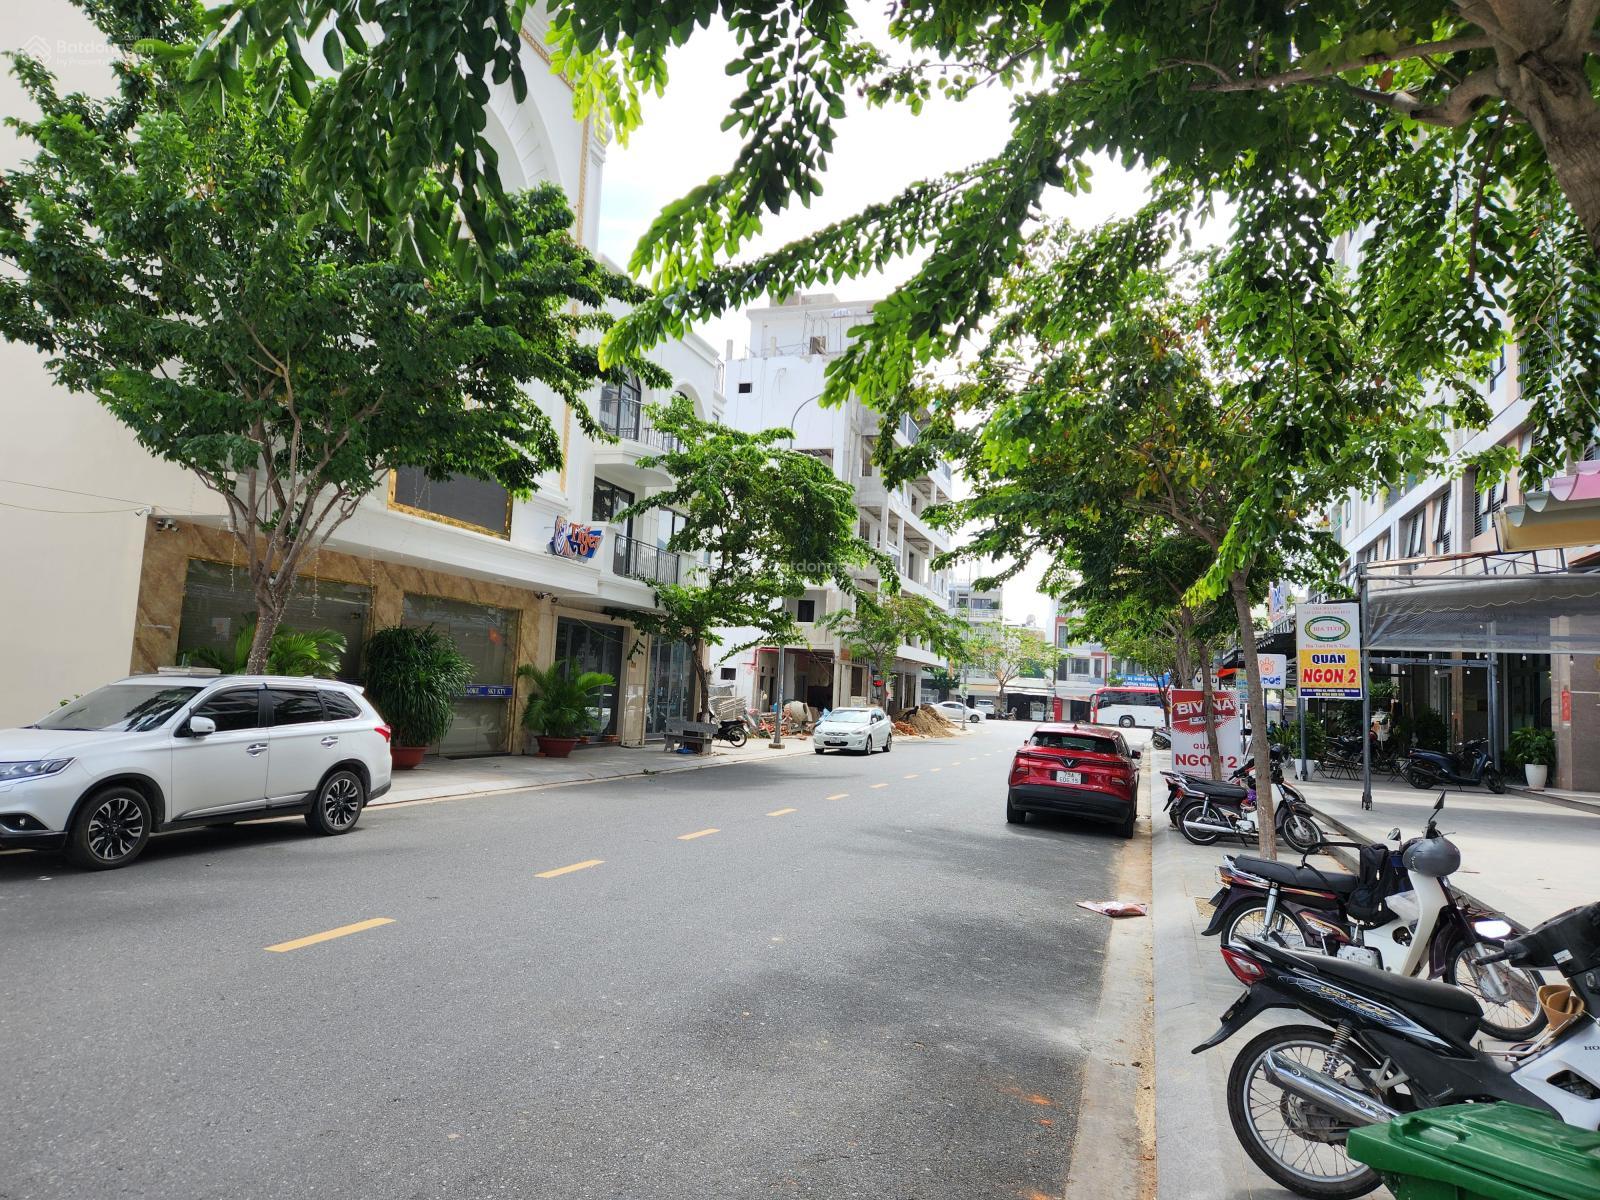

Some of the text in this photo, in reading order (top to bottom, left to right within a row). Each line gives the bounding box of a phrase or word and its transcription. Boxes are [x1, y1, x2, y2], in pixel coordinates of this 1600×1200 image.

[569, 522, 602, 556] Tiger
[1312, 654, 1345, 664] QUAN
[1303, 668, 1357, 683] NGON 2
[1177, 698, 1235, 715] BIVNA
[1227, 756, 1238, 769] 2
